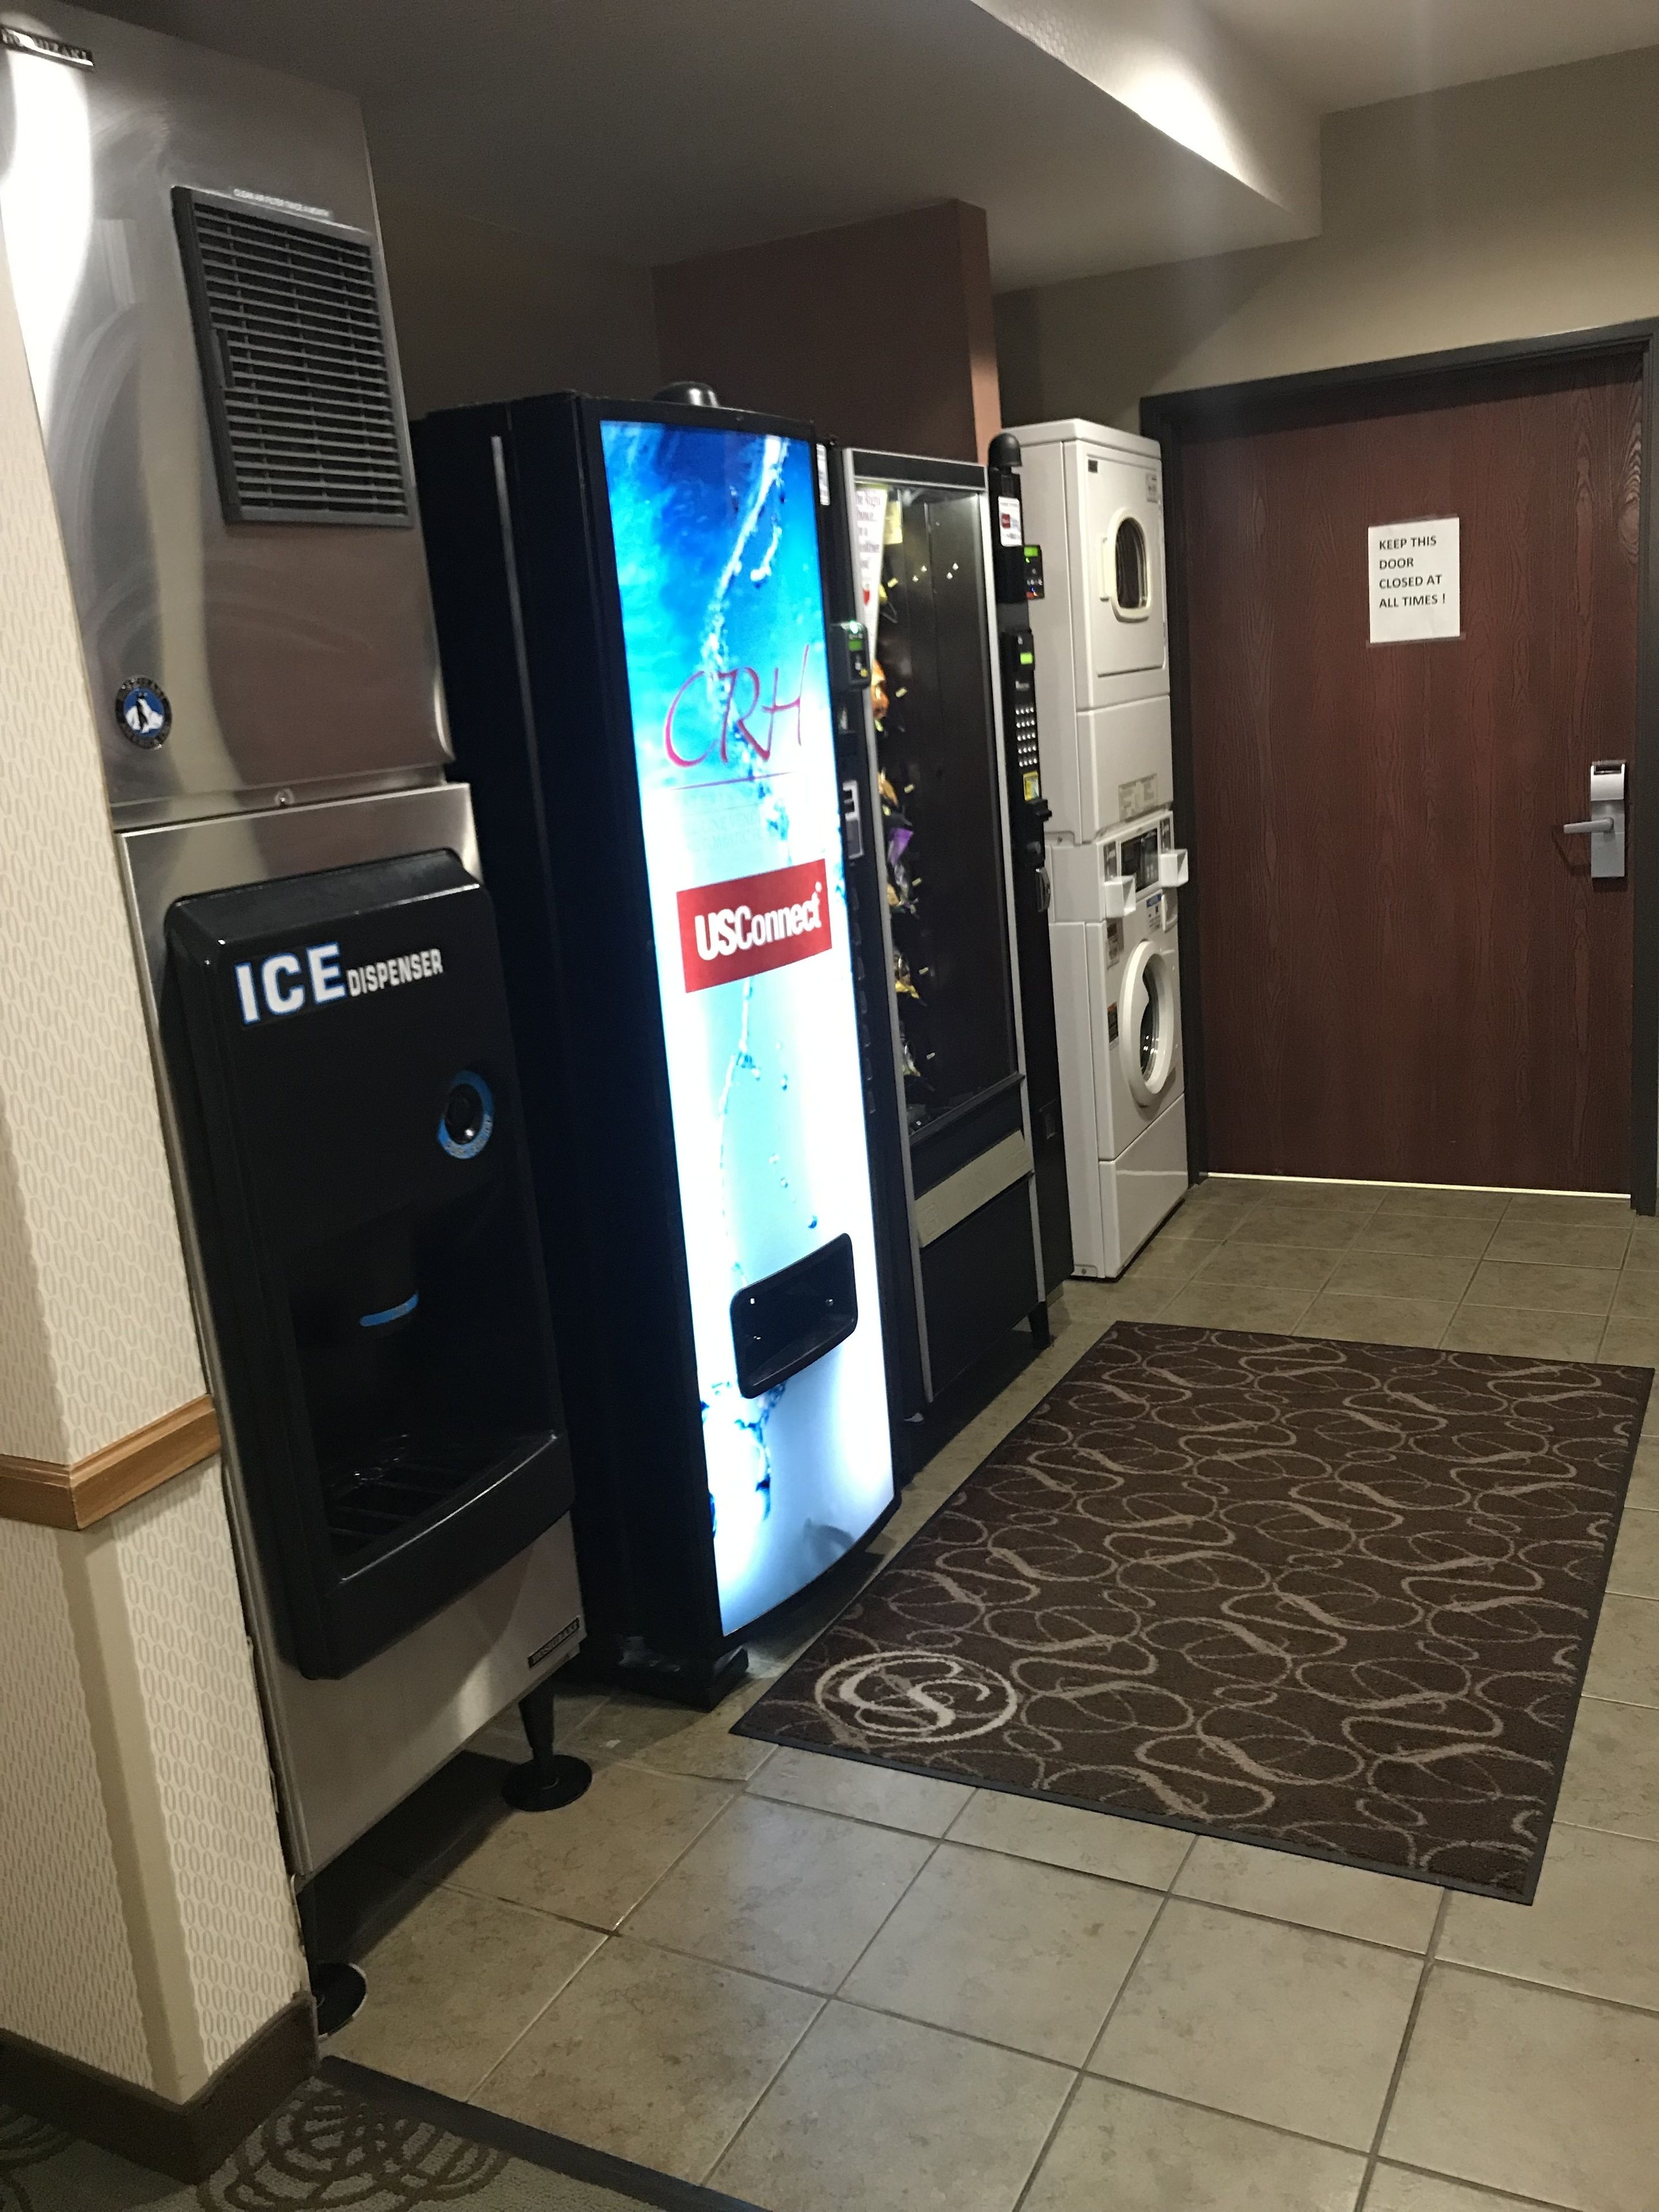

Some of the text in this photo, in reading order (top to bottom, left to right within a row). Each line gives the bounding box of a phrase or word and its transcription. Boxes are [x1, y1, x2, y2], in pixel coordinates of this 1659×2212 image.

[1379, 535, 1437, 550] KEEP THIS
[1379, 558, 1414, 570] DOOR
[1379, 574, 1442, 589] CLOSED AT
[1379, 597, 1399, 608] ALL
[1402, 594, 1438, 607] TIMES
[234, 941, 444, 1025] ICE DISPENSER
